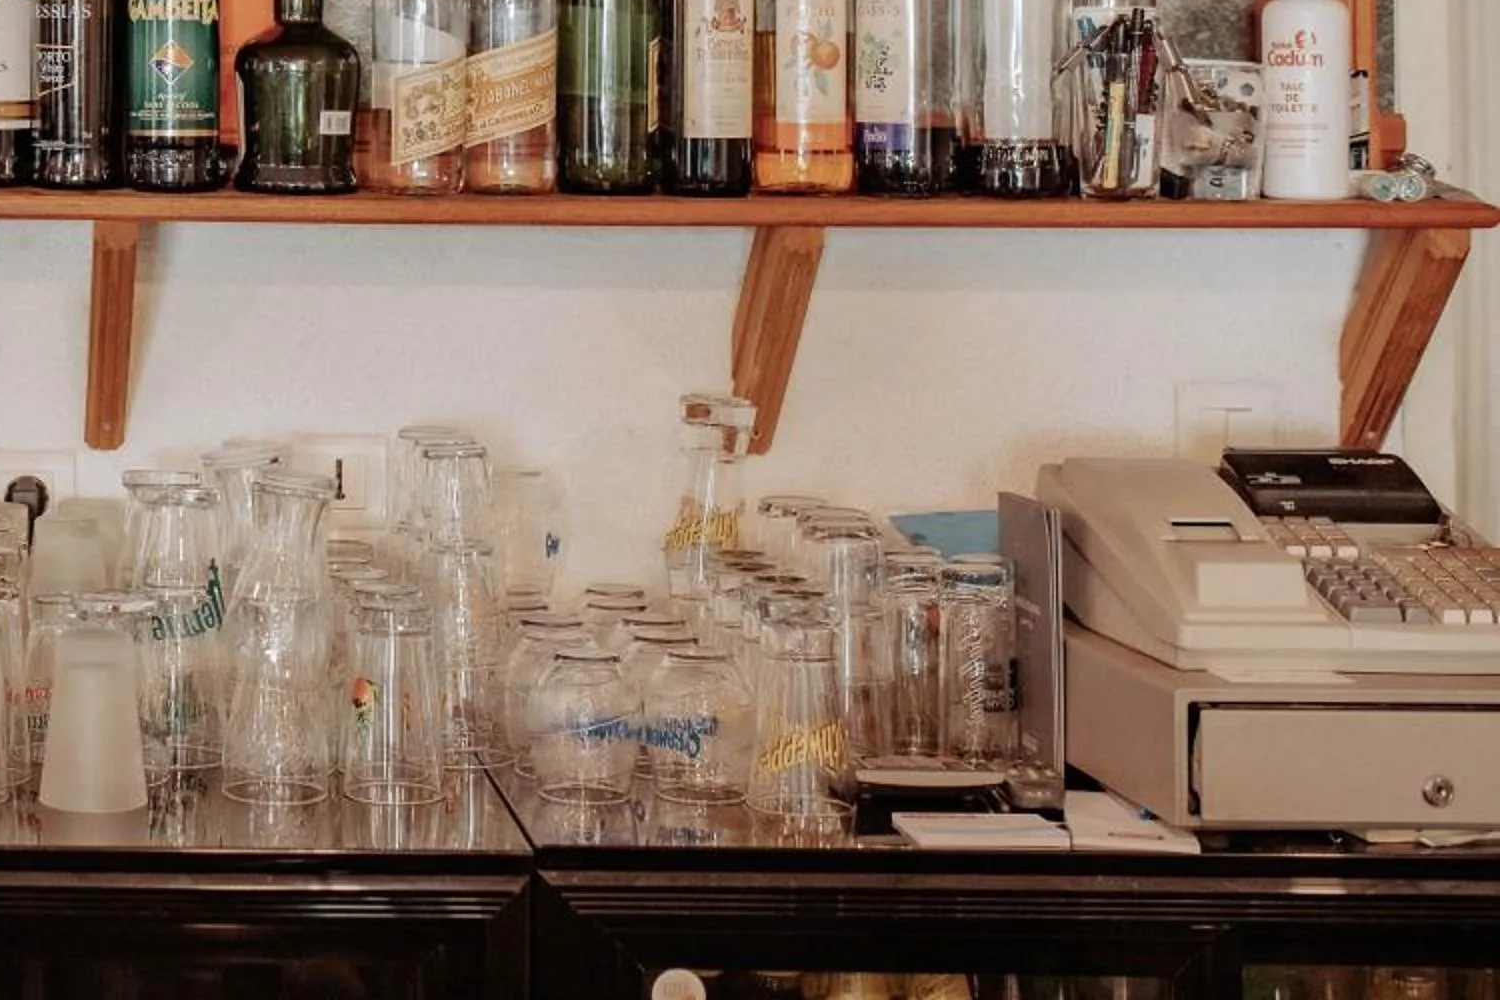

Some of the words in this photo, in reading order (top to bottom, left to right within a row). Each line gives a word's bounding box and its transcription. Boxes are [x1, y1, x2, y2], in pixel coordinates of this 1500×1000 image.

[36, 4, 92, 19] ESSIAS
[1284, 93, 1300, 102] DE
[1270, 103, 1319, 115] TOILETE
